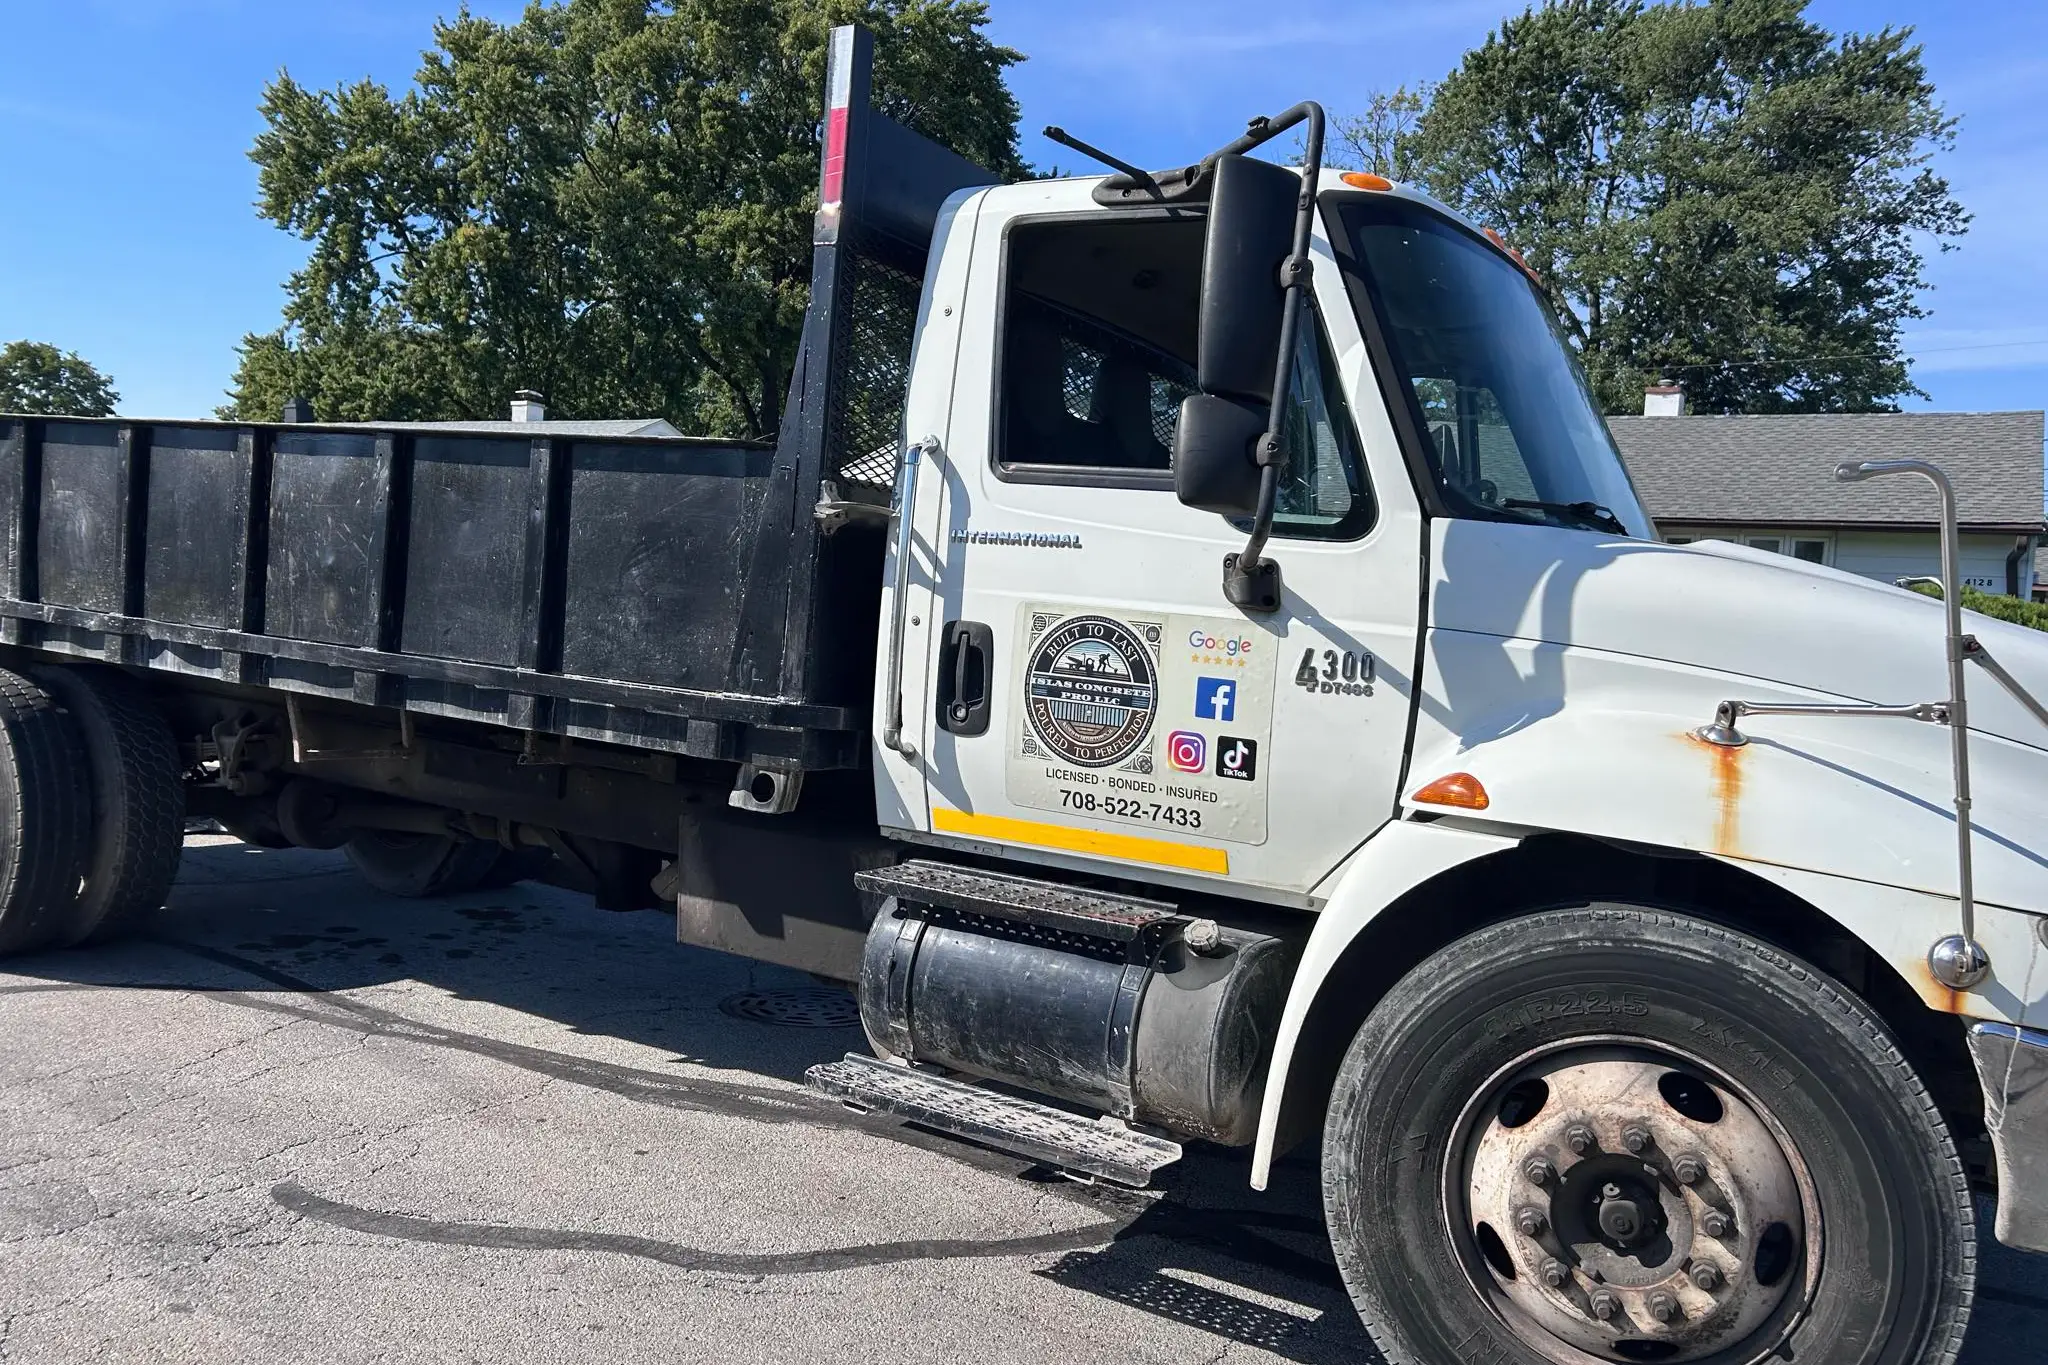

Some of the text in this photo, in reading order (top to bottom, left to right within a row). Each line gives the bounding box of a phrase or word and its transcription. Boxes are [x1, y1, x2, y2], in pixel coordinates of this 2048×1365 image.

[950, 529, 1083, 549] INTERNATIONAL
[1965, 578, 1993, 586] 4128
[1046, 624, 1140, 663] BUILT TO LAST
[1188, 630, 1252, 656] Google
[1295, 647, 1377, 693] 4300
[1031, 677, 1151, 697] ISLAS CONCRETE
[1060, 691, 1121, 705] PRO LLC
[1035, 703, 1068, 749] POURED
[1073, 746, 1090, 758] TO
[1094, 710, 1147, 758] PERFECTION
[1045, 768, 1219, 803] LICENSED BONDED INSURED
[1222, 767, 1248, 779] TikTok
[1059, 788, 1202, 829] 708-522-7433
